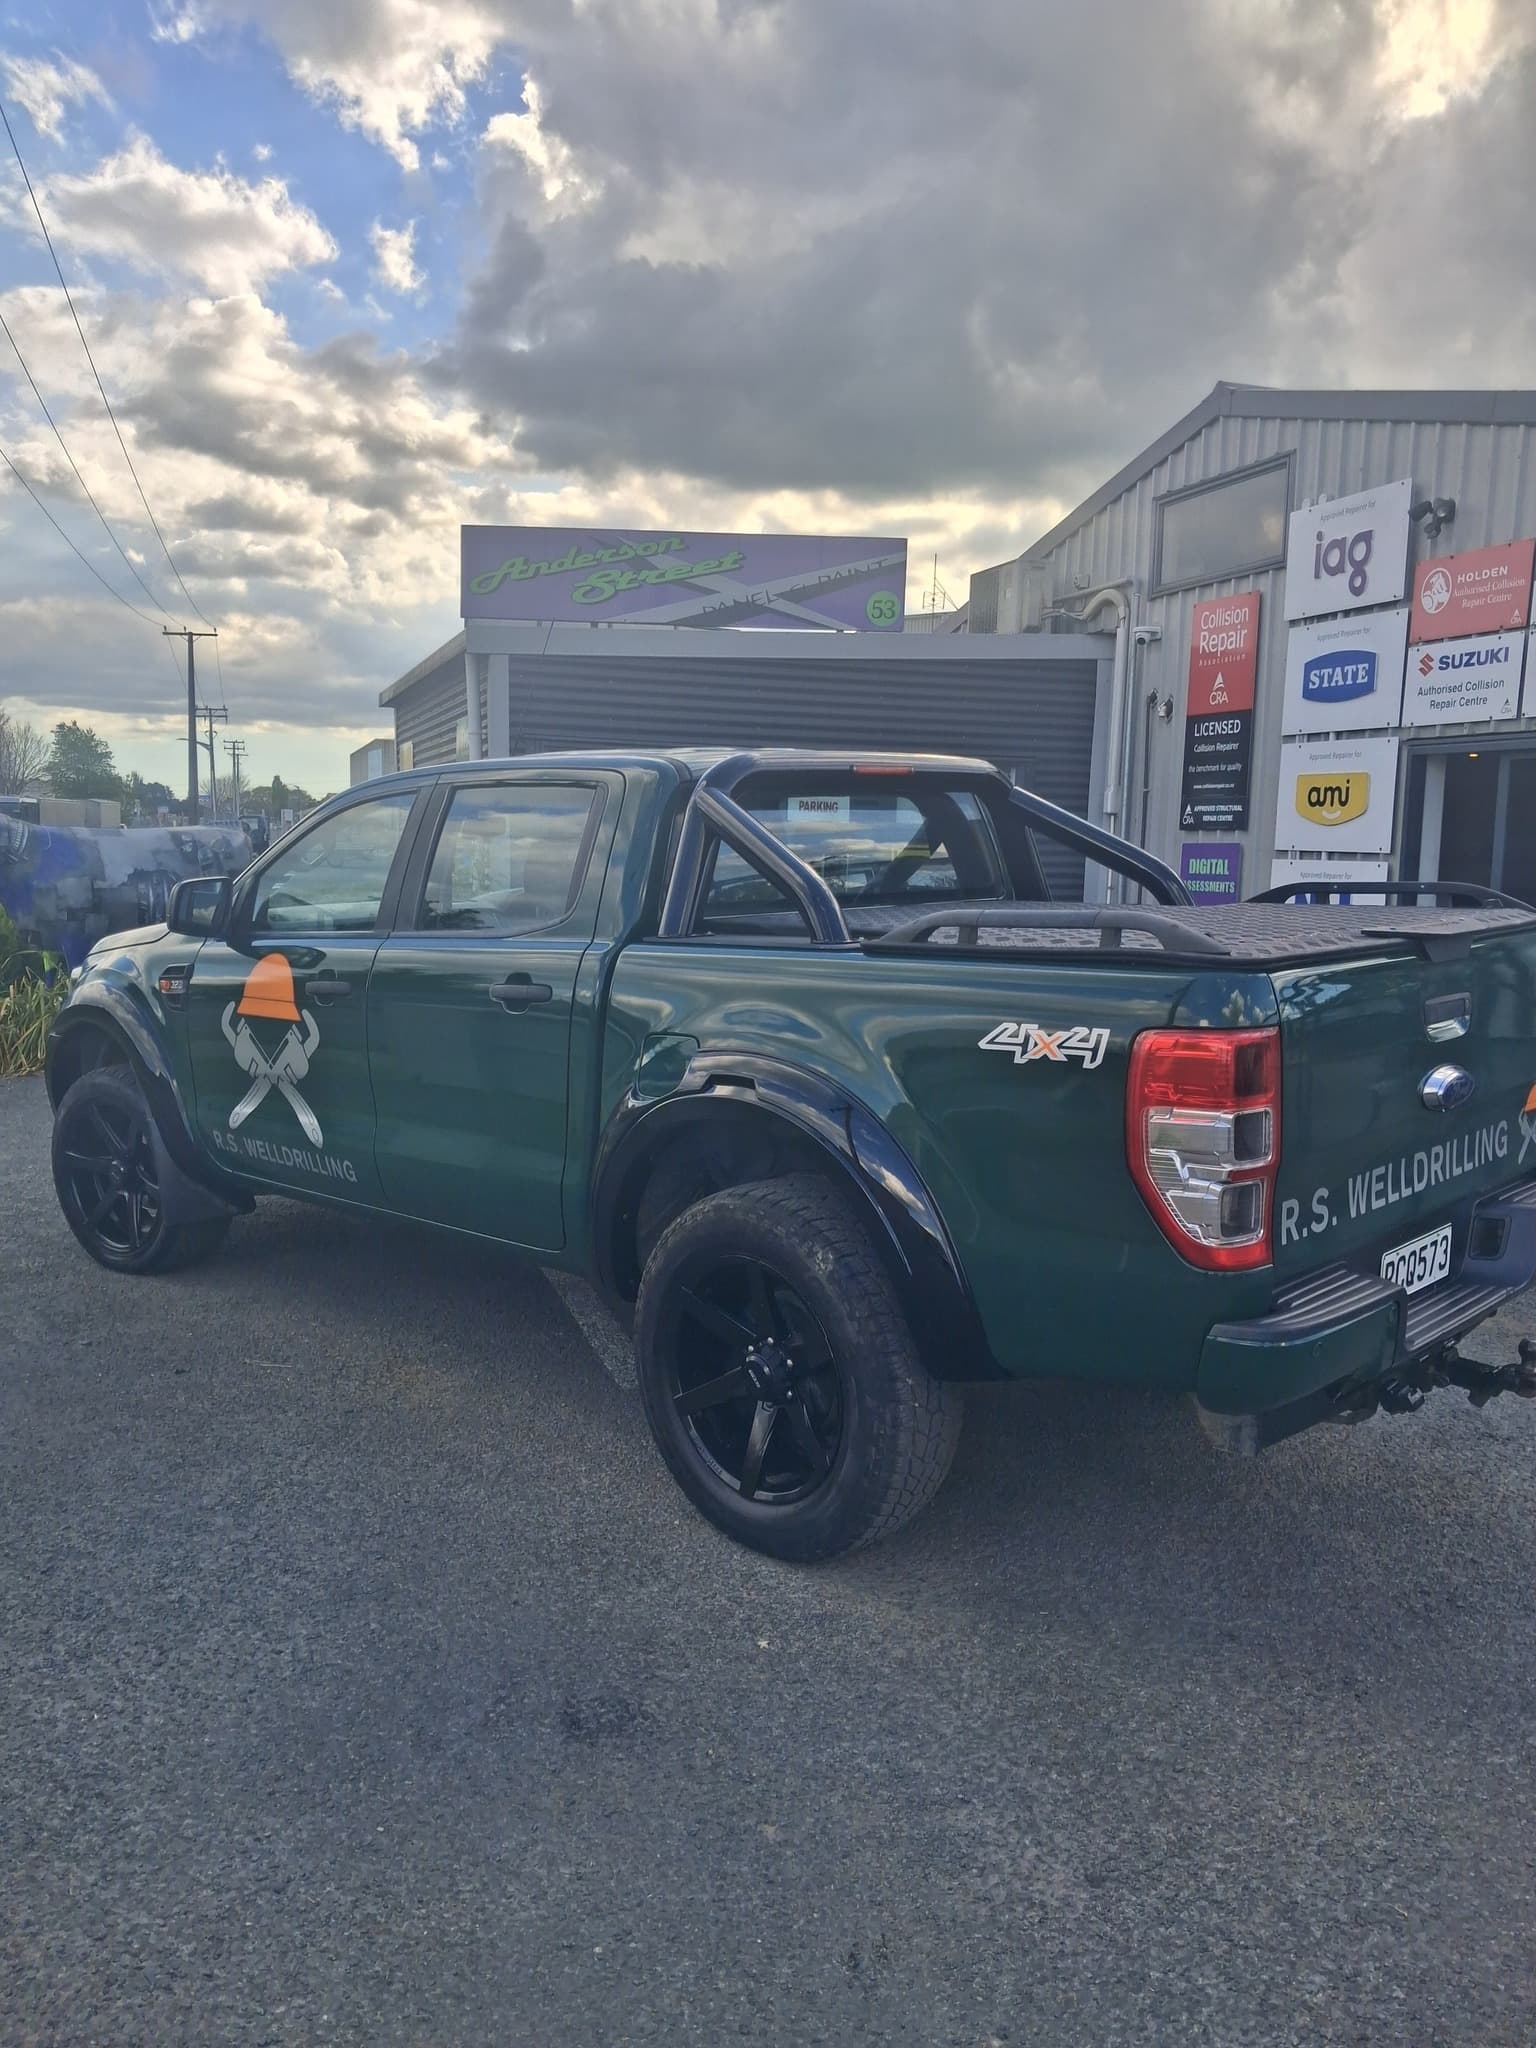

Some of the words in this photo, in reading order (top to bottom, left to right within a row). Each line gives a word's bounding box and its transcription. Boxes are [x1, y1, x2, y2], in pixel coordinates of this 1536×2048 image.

[469, 536, 686, 595] Anderson
[1314, 530, 1373, 597] iag
[571, 551, 744, 605] Street
[1457, 565, 1508, 584] HOLDEN
[1492, 577, 1525, 591] Collision
[871, 600, 896, 619] 53
[1462, 597, 1486, 609] Repair
[1487, 593, 1513, 604] Centre
[1201, 605, 1249, 630] Collision
[1199, 625, 1247, 656] Repair
[1438, 647, 1510, 671] SUZUKI
[1308, 664, 1369, 689] STATE
[1417, 682, 1463, 696] Authorised
[1465, 679, 1505, 692] Collision
[1209, 691, 1229, 705] CRA
[1430, 699, 1457, 711] Repair
[1458, 696, 1488, 707] Centre
[1194, 720, 1241, 737] LICENSED
[1193, 743, 1216, 753] Collision
[1216, 742, 1240, 753] Repairer
[1307, 778, 1350, 808] ami
[799, 800, 839, 813] PARKING
[1188, 858, 1229, 875] DIGITAL
[212, 1130, 243, 1155] R.S.
[243, 1136, 358, 1183] WELLDRILLING
[1281, 1187, 1337, 1246] R.S.
[1348, 1120, 1508, 1219] WELLDRILLING
